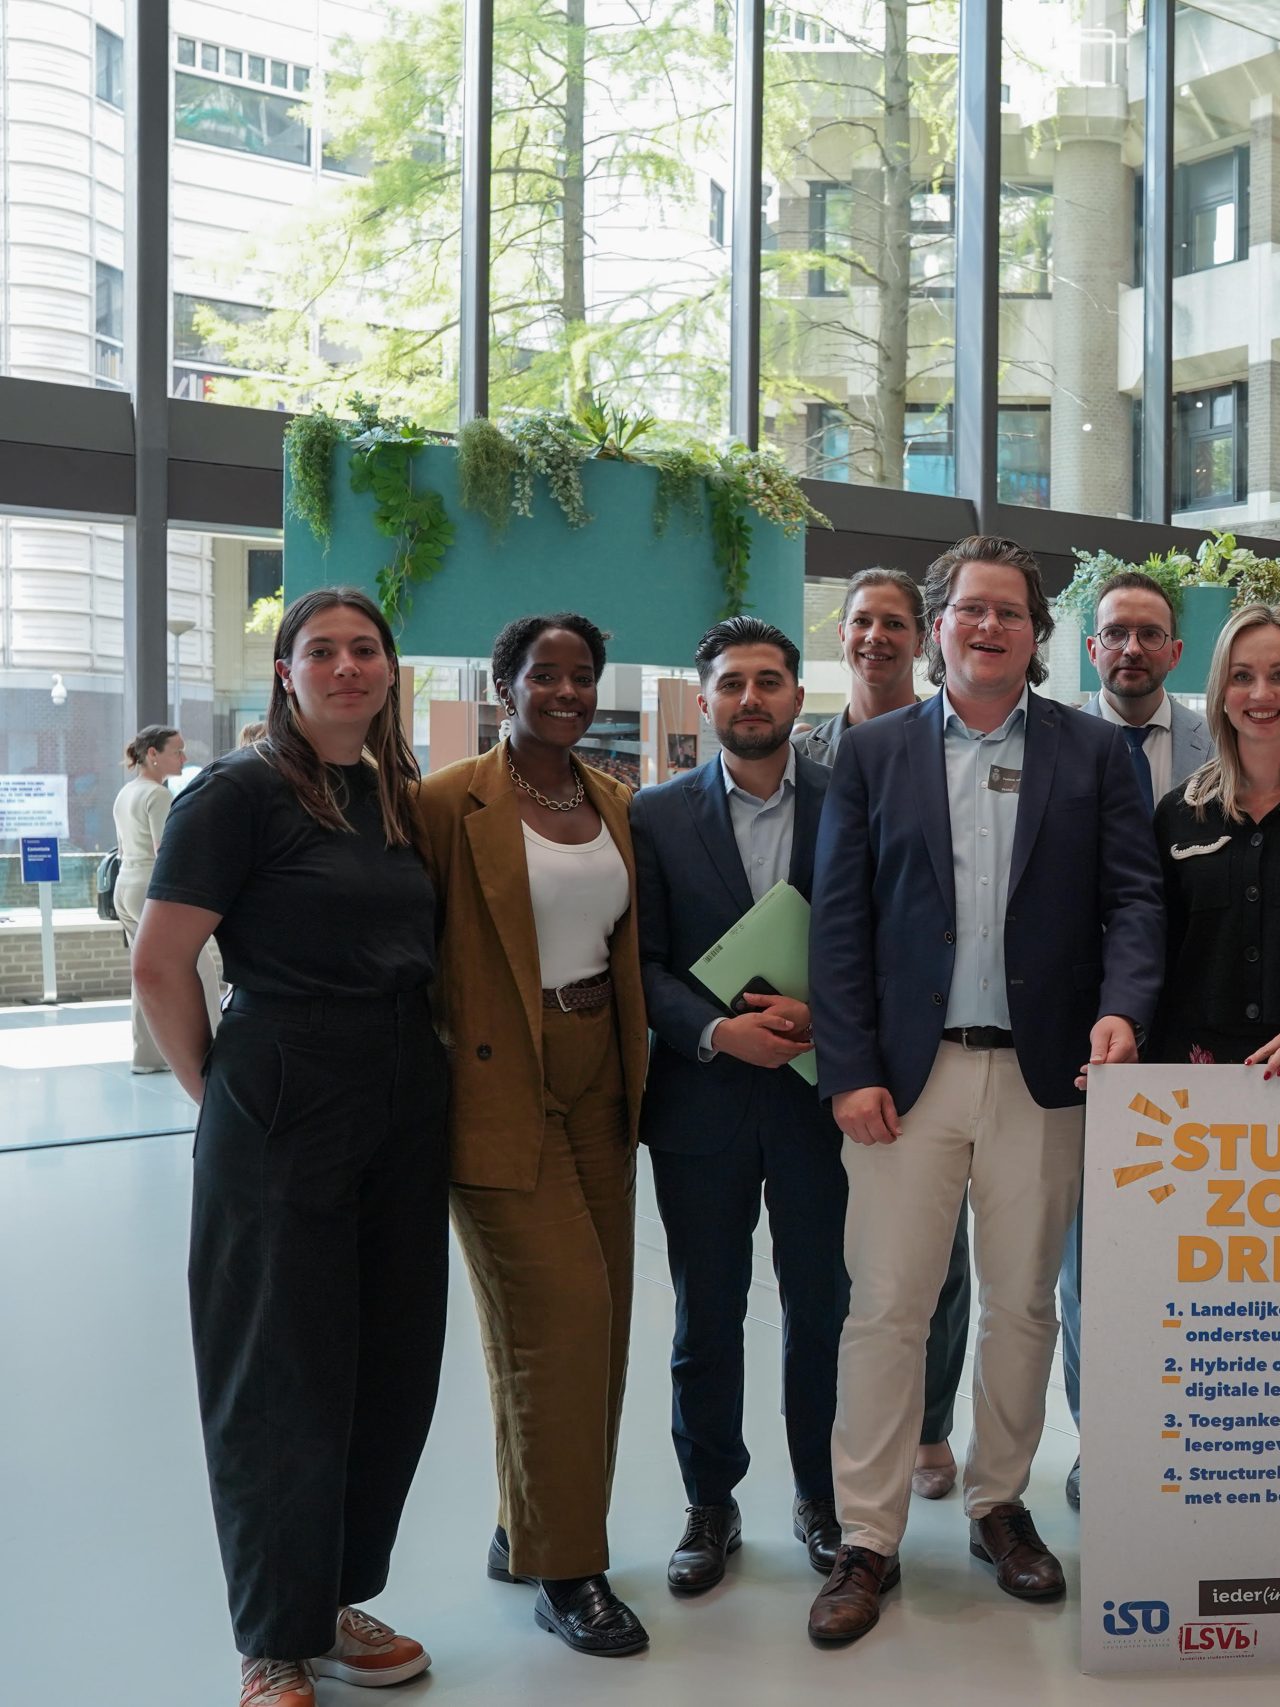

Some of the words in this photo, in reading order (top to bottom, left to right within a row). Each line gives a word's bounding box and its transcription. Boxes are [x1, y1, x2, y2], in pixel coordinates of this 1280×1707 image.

[1166, 1302, 1184, 1317] 1.
[1164, 1357, 1183, 1372] 2.
[1190, 1356, 1268, 1376] Hybride
[1185, 1381, 1259, 1401] digitale
[1164, 1413, 1183, 1428] 3.
[1163, 1467, 1183, 1481] 4.
[1185, 1491, 1222, 1505] met
[1226, 1492, 1261, 1504] een
